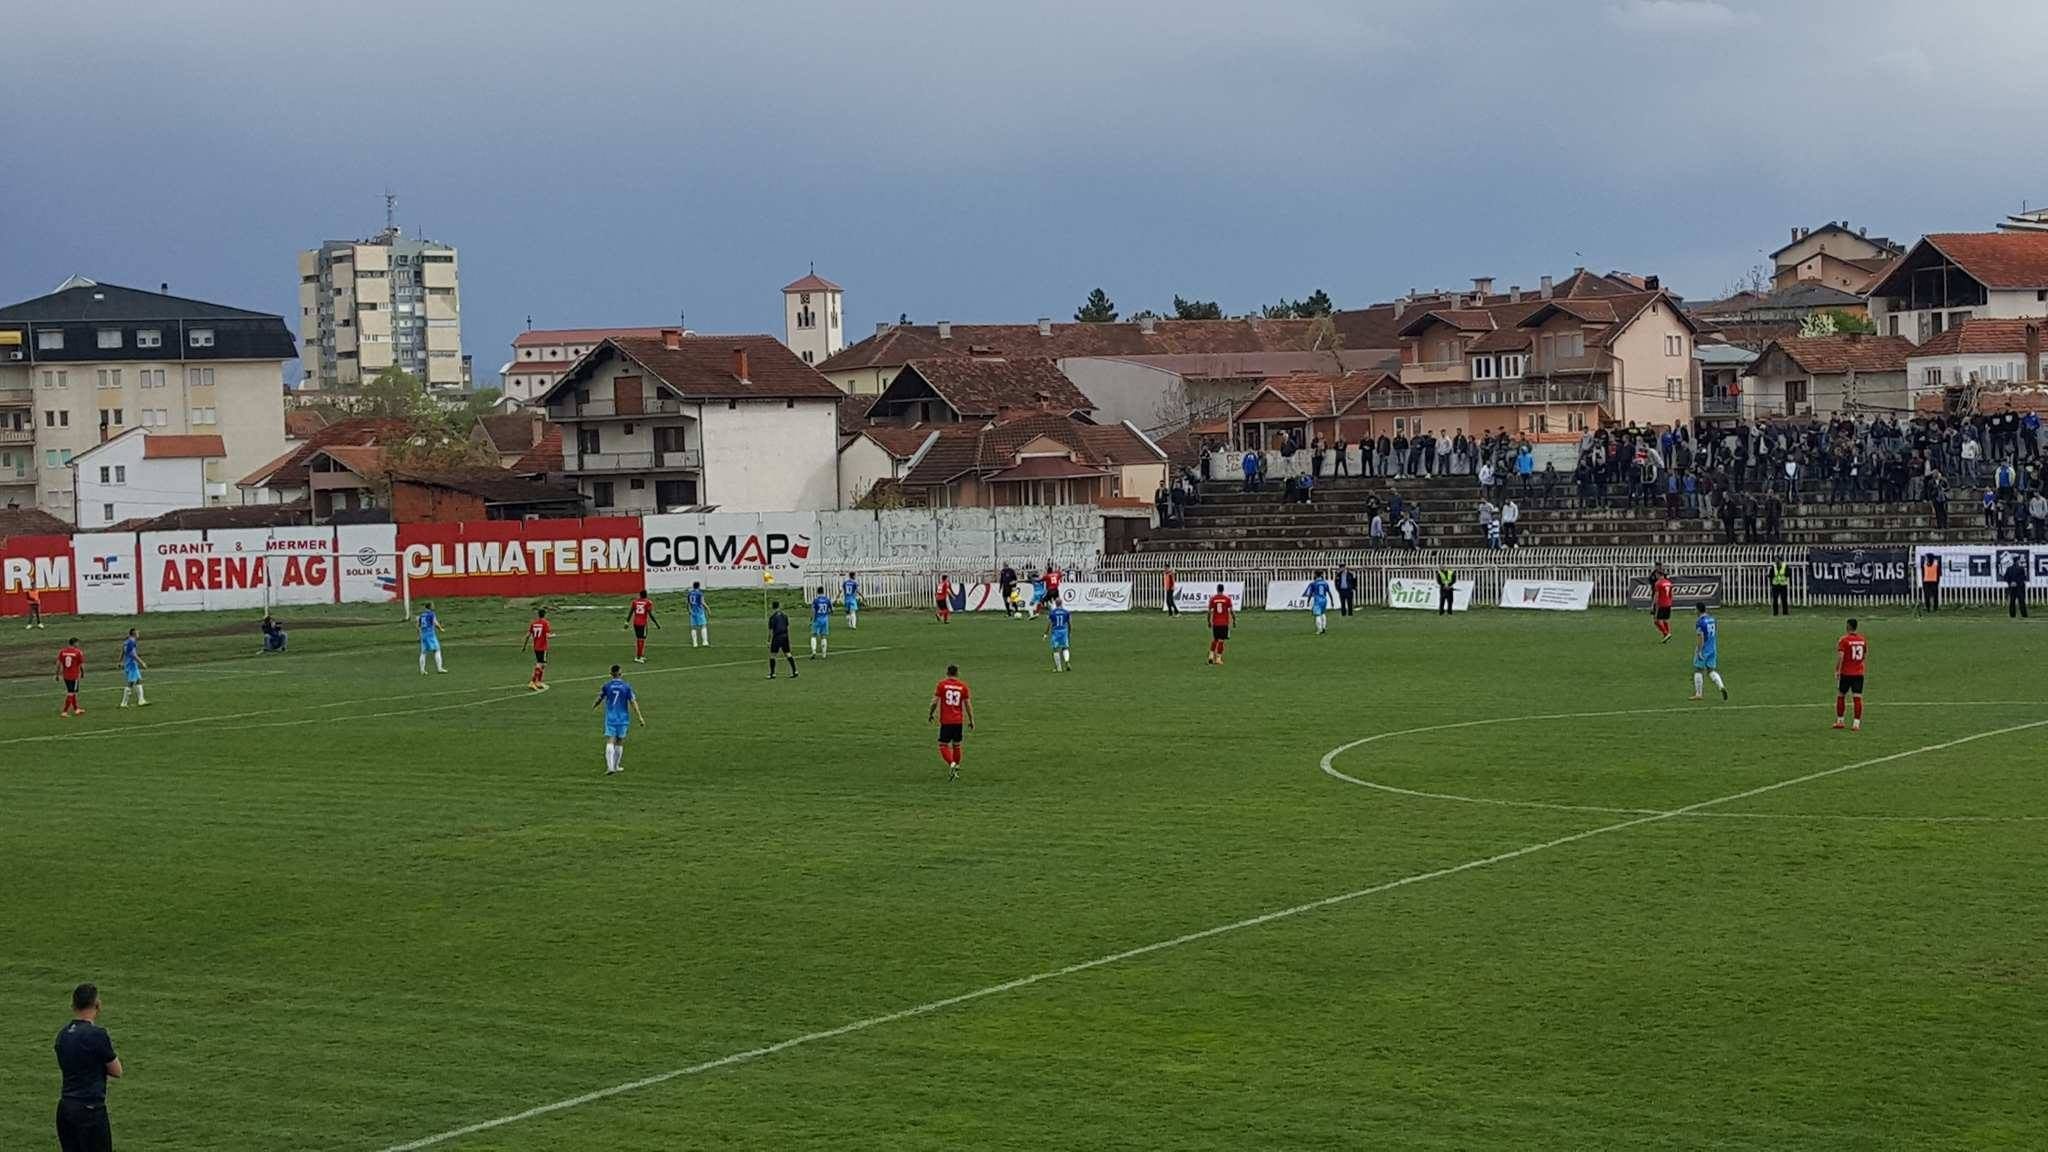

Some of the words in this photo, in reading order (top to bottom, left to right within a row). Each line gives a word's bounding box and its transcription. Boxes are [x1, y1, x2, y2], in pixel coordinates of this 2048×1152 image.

[158, 543, 214, 555] GRANIT
[235, 541, 243, 552] &
[266, 539, 327, 551] MERMER
[645, 534, 789, 567] COMAP
[403, 537, 640, 579] CLIMATERM
[4, 556, 71, 594] RM
[83, 573, 130, 581] TIEMME
[161, 555, 272, 592] ARENA
[281, 555, 327, 587] AG
[346, 568, 373, 576] SOLIN
[1182, 593, 1201, 601] NAS
[1851, 646, 1863, 660] 13
[612, 690, 620, 705] 7
